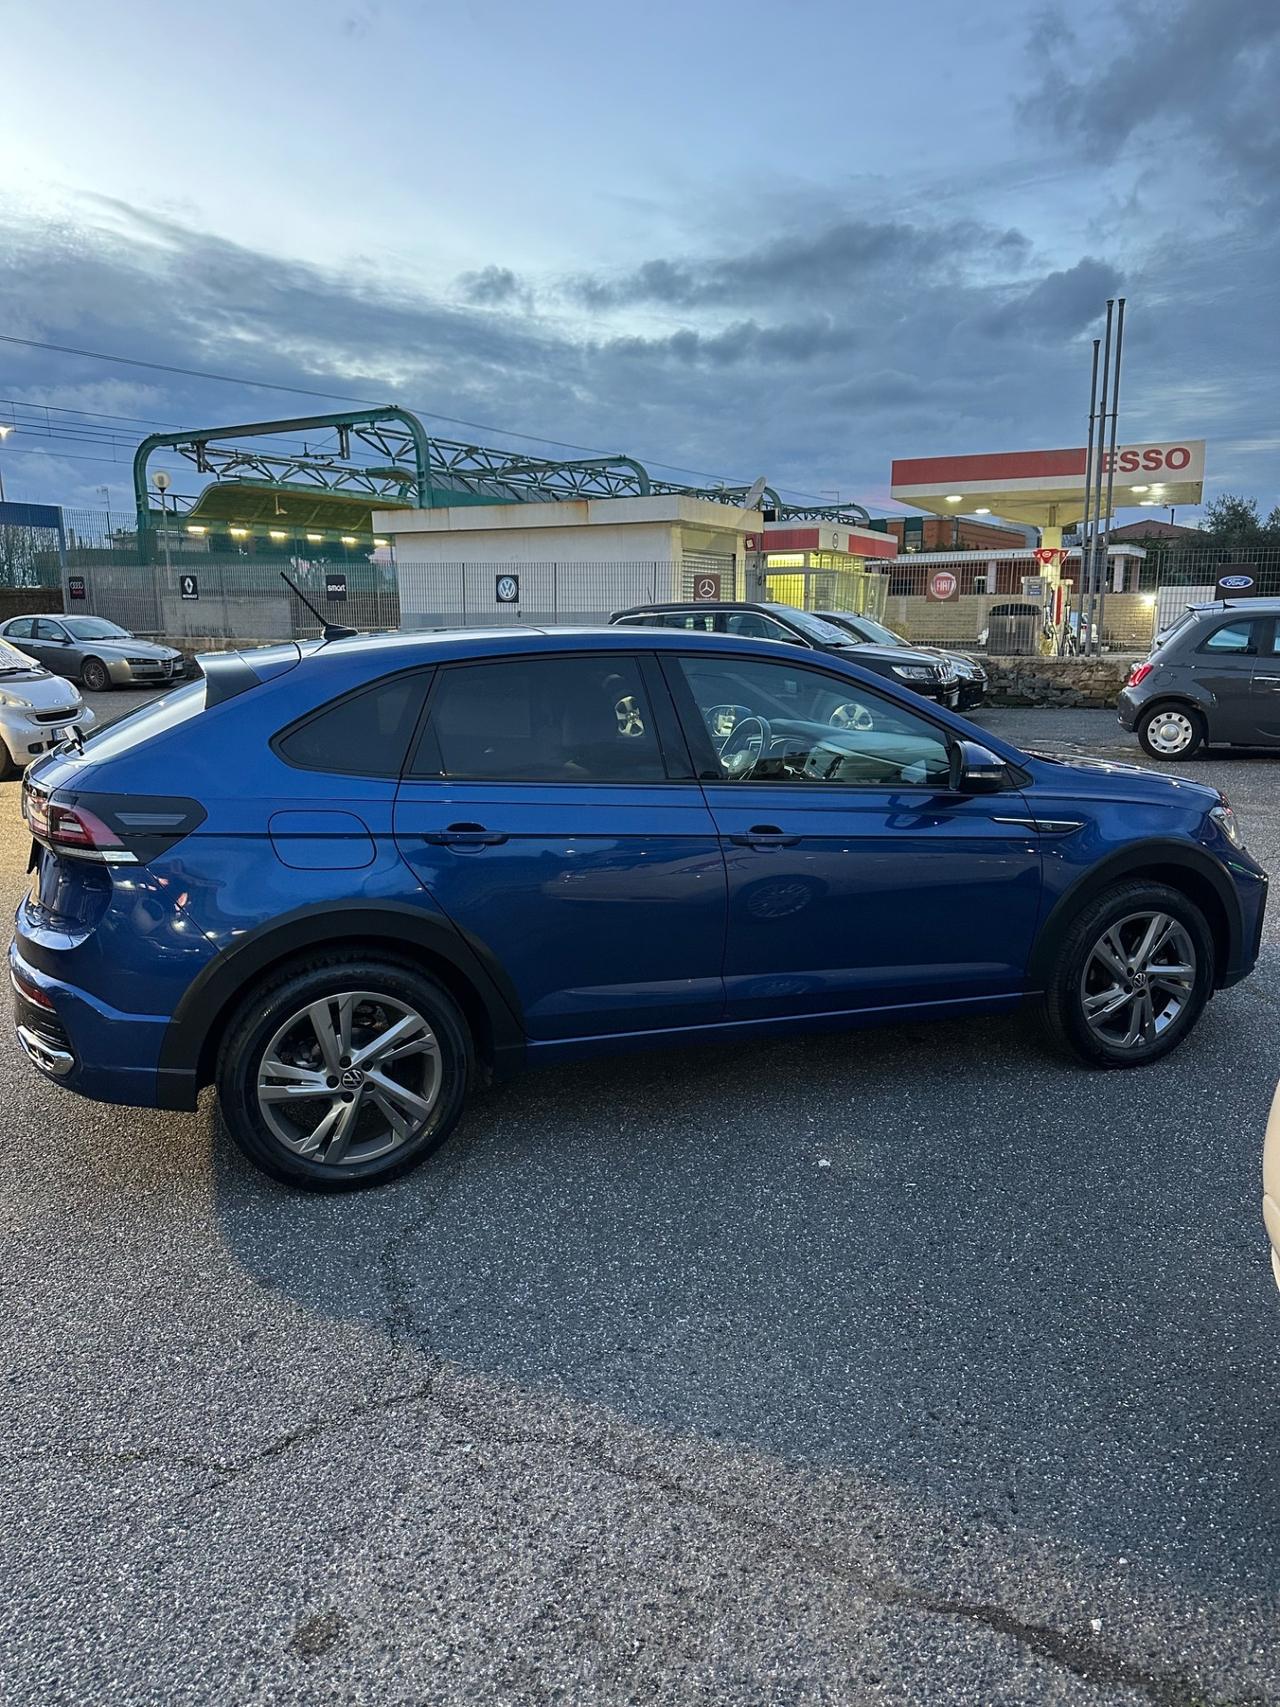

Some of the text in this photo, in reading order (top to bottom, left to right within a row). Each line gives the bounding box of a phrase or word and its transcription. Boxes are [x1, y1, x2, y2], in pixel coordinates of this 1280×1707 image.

[1102, 447, 1191, 473] ESSO
[327, 584, 346, 592] smart
[936, 579, 954, 591] FIAT
